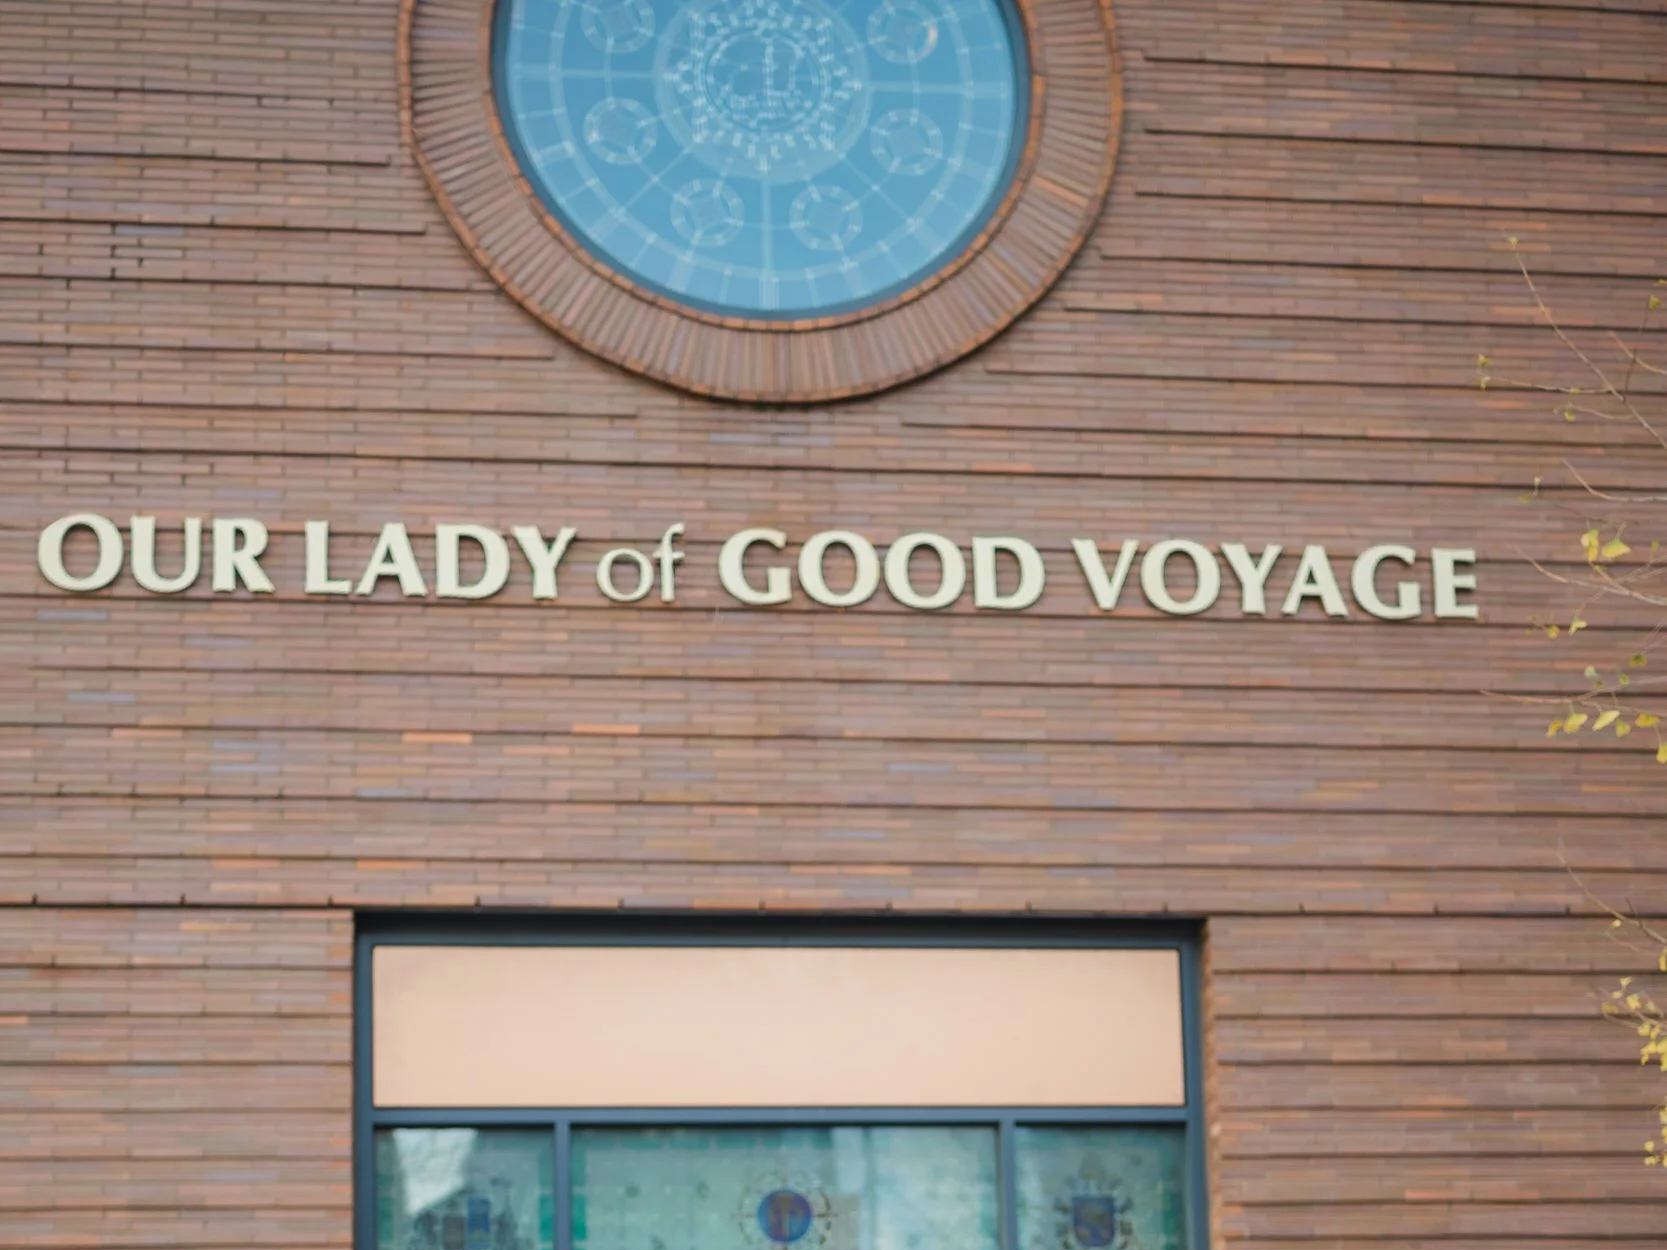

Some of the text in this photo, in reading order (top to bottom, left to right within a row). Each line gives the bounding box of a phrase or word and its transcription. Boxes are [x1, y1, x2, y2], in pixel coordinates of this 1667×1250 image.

[36, 510, 1480, 620] OUR LADY of GOOD VOYAGE
